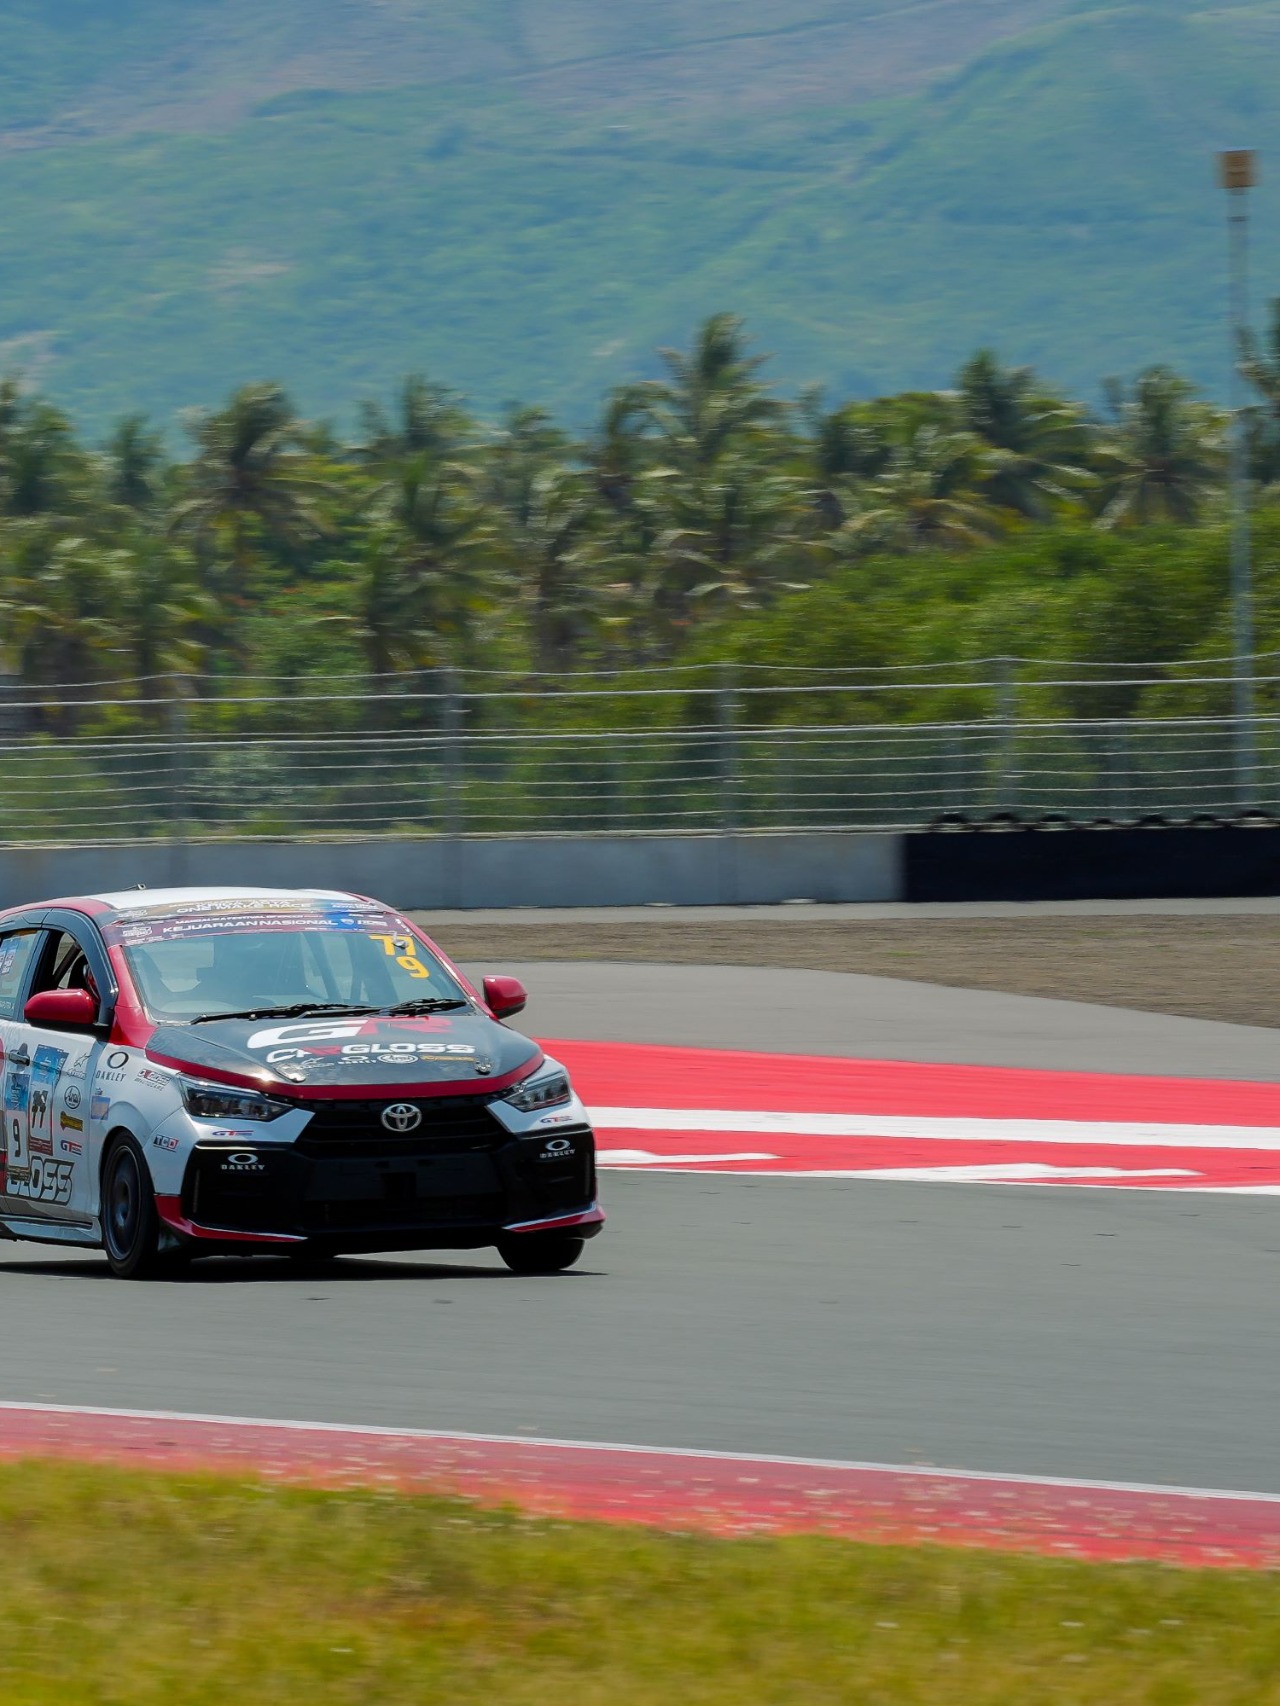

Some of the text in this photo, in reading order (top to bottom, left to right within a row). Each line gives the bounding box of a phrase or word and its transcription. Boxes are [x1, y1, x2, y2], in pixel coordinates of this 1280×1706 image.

[162, 921, 258, 933] KEJUARAAN
[368, 934, 416, 956] 77
[395, 955, 430, 978] 9
[246, 1016, 458, 1049] GR
[95, 1070, 126, 1082] OAKLEY
[12, 1118, 22, 1158] 9
